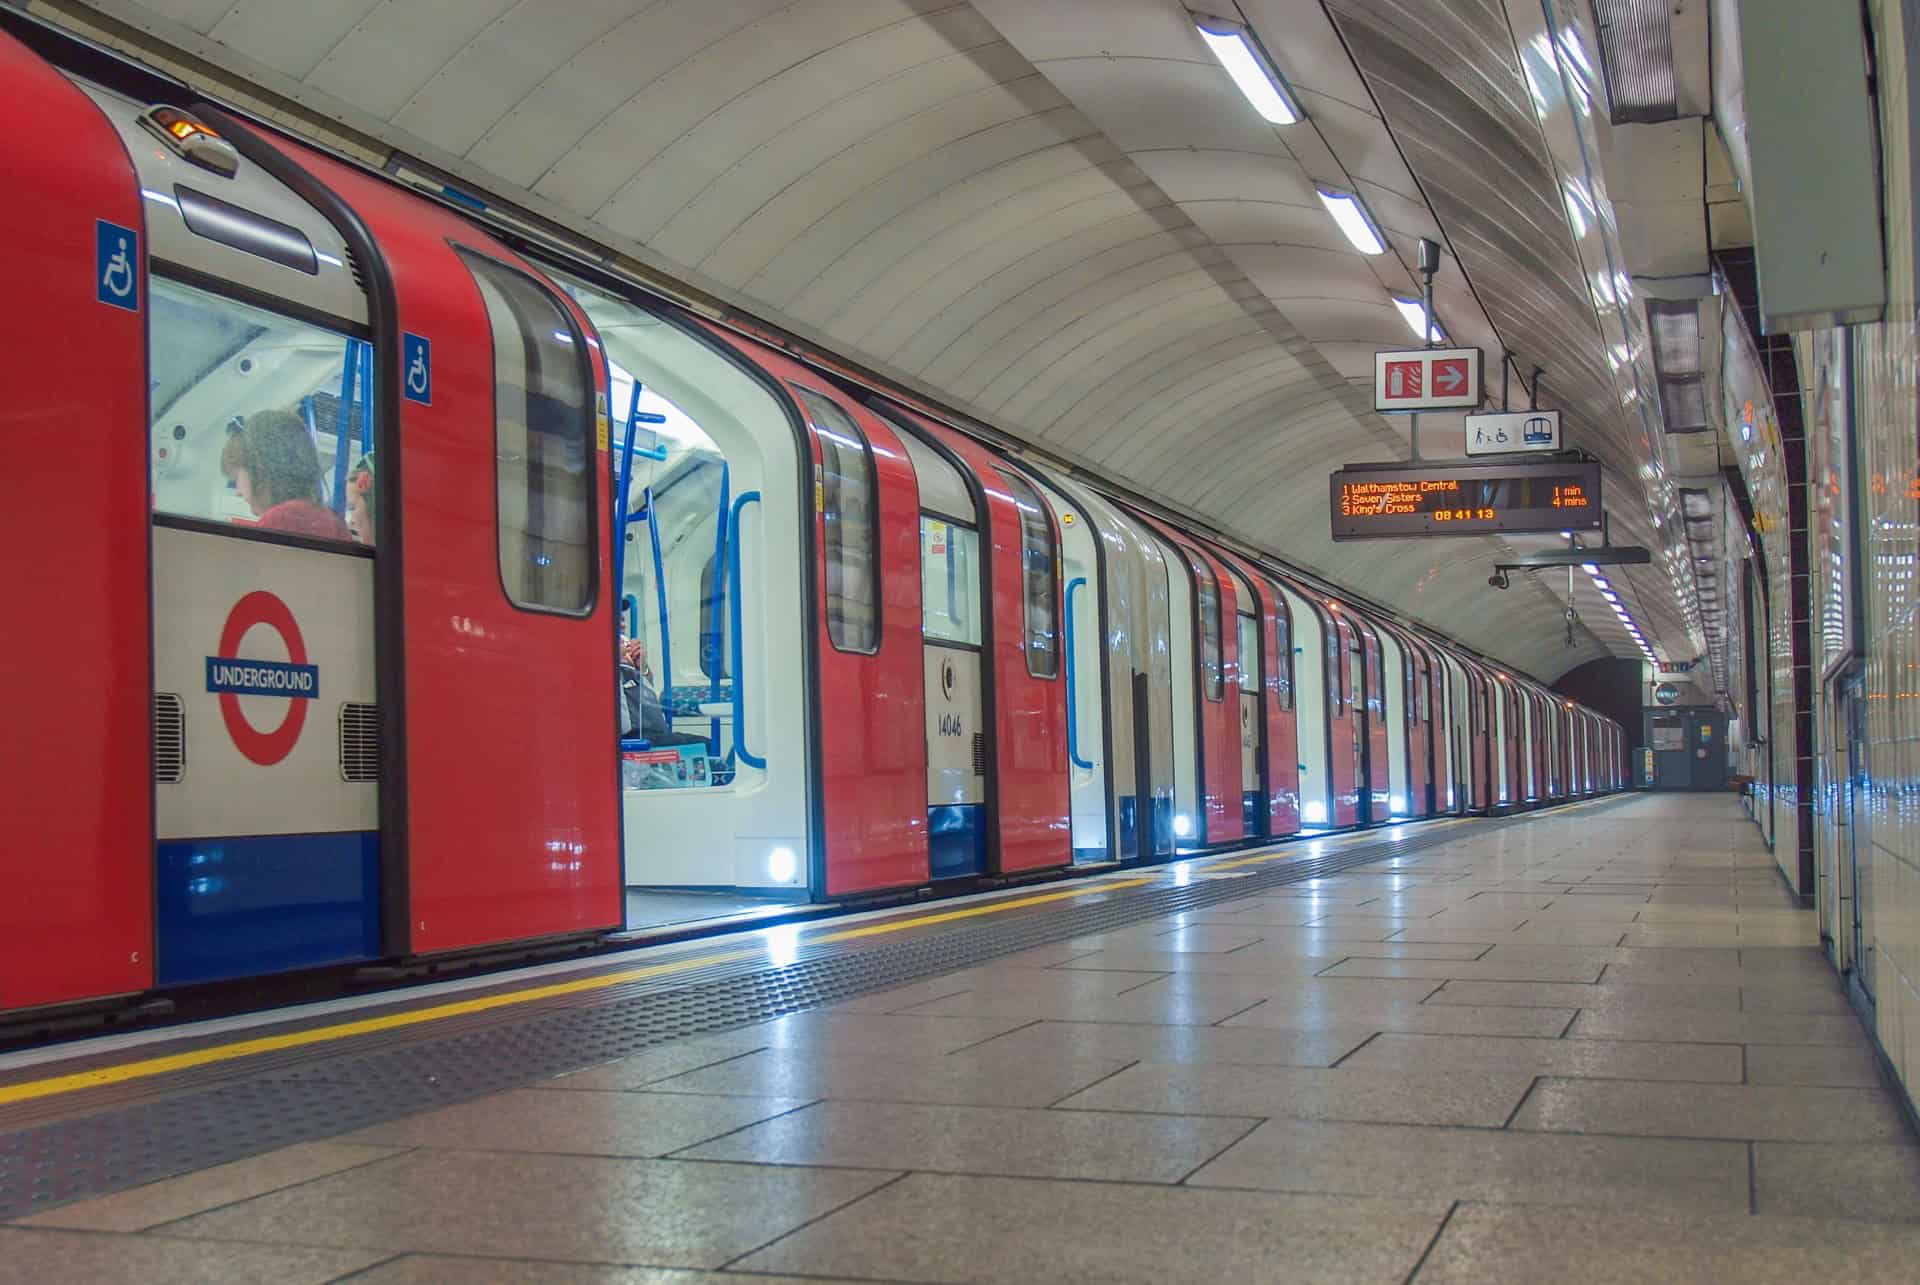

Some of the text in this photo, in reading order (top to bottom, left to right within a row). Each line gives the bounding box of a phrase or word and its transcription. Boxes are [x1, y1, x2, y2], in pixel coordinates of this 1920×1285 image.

[1343, 480, 1457, 494] 1 Walthamstow Central
[1554, 485, 1582, 497] 1 min
[1342, 493, 1424, 505] 2 Seven Sisters
[1552, 496, 1588, 508] 4 mins
[1342, 503, 1416, 516] 3 King's Cross
[213, 664, 314, 690] UNDERGROUND
[938, 712, 962, 737] 14046
